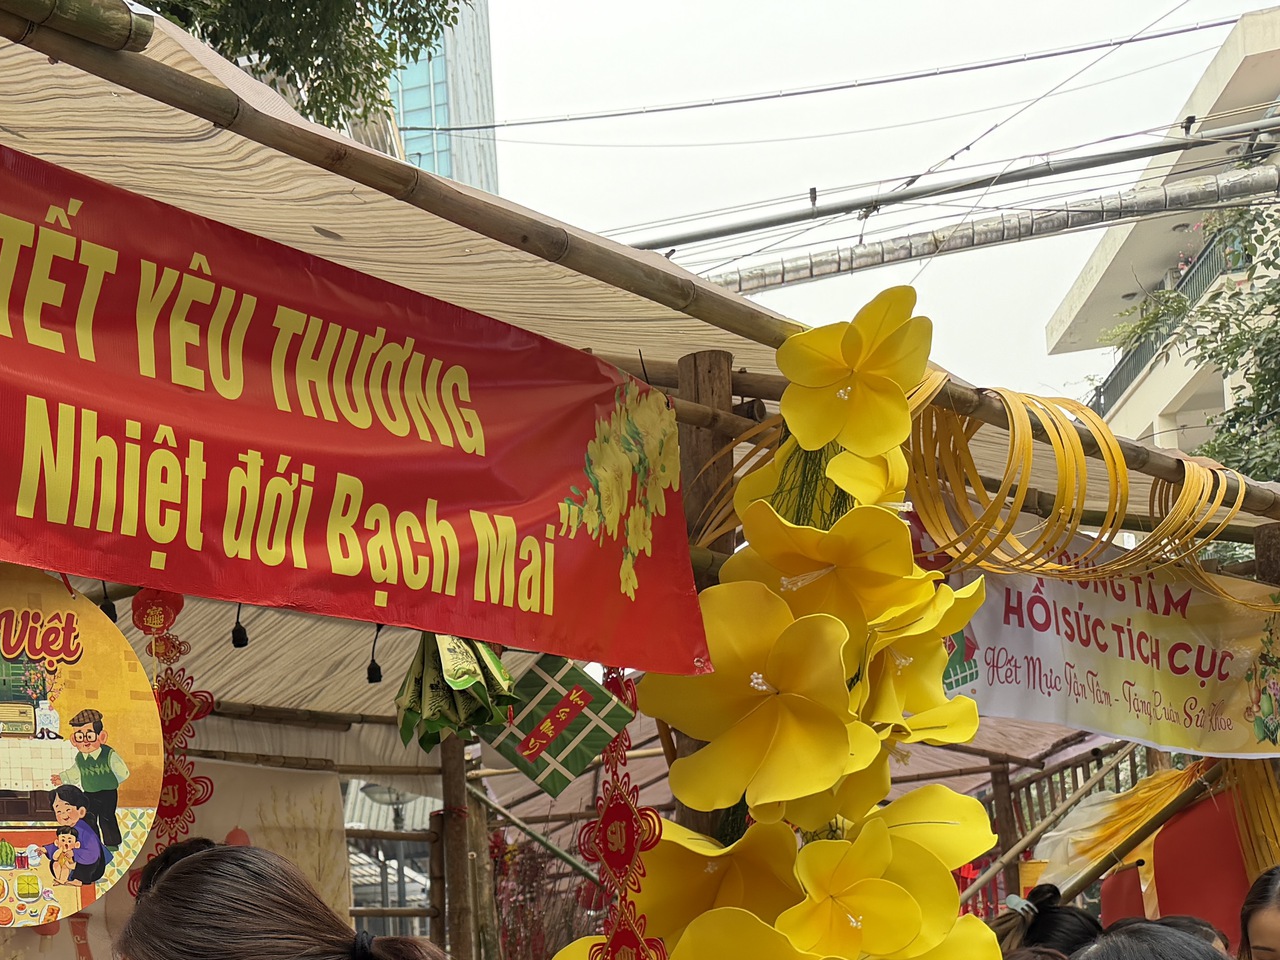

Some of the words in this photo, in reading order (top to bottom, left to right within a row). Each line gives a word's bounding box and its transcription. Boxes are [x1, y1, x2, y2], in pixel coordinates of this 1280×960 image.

[137, 252, 257, 400] YÊU
[272, 306, 487, 456] THƯƠNG
[16, 395, 207, 570] Nhiệt
[222, 450, 316, 569] đới
[325, 472, 459, 608] Bạch
[1003, 577, 1061, 636] HỒI
[1061, 602, 1109, 653] SỨC
[1111, 617, 1160, 671] TÍCH
[1167, 642, 1235, 689] CỰC
[1129, 570, 1192, 619] TÂM
[984, 646, 1022, 687] Hết
[1024, 655, 1063, 697] Mực
[1064, 661, 1088, 704] Tận
[1086, 669, 1113, 707] Tâm
[1122, 680, 1153, 725] Tặng
